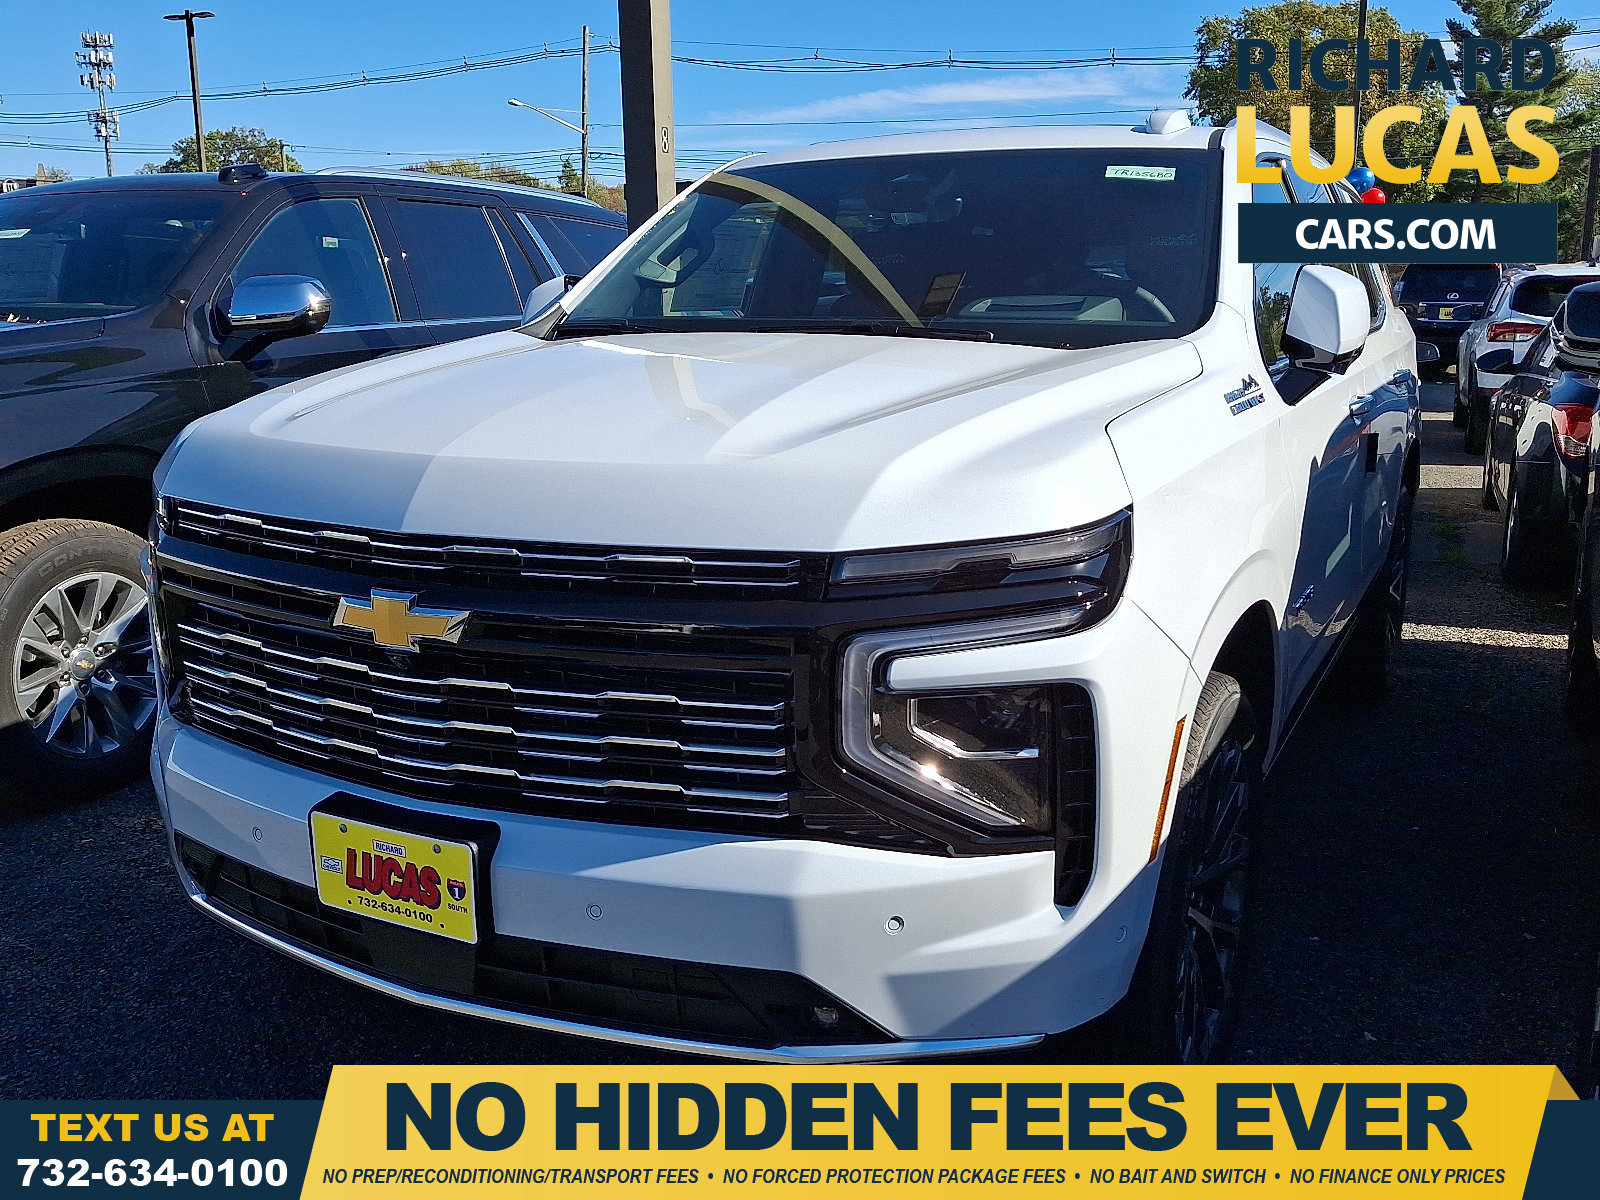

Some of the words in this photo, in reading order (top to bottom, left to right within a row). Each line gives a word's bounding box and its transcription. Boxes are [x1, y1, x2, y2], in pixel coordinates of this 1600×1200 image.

[375, 842, 403, 855] RICHARD
[346, 848, 441, 910] LUCAS
[453, 887, 461, 900] 1
[357, 895, 433, 923] 732-634-0100
[447, 902, 468, 914] SOUTH
